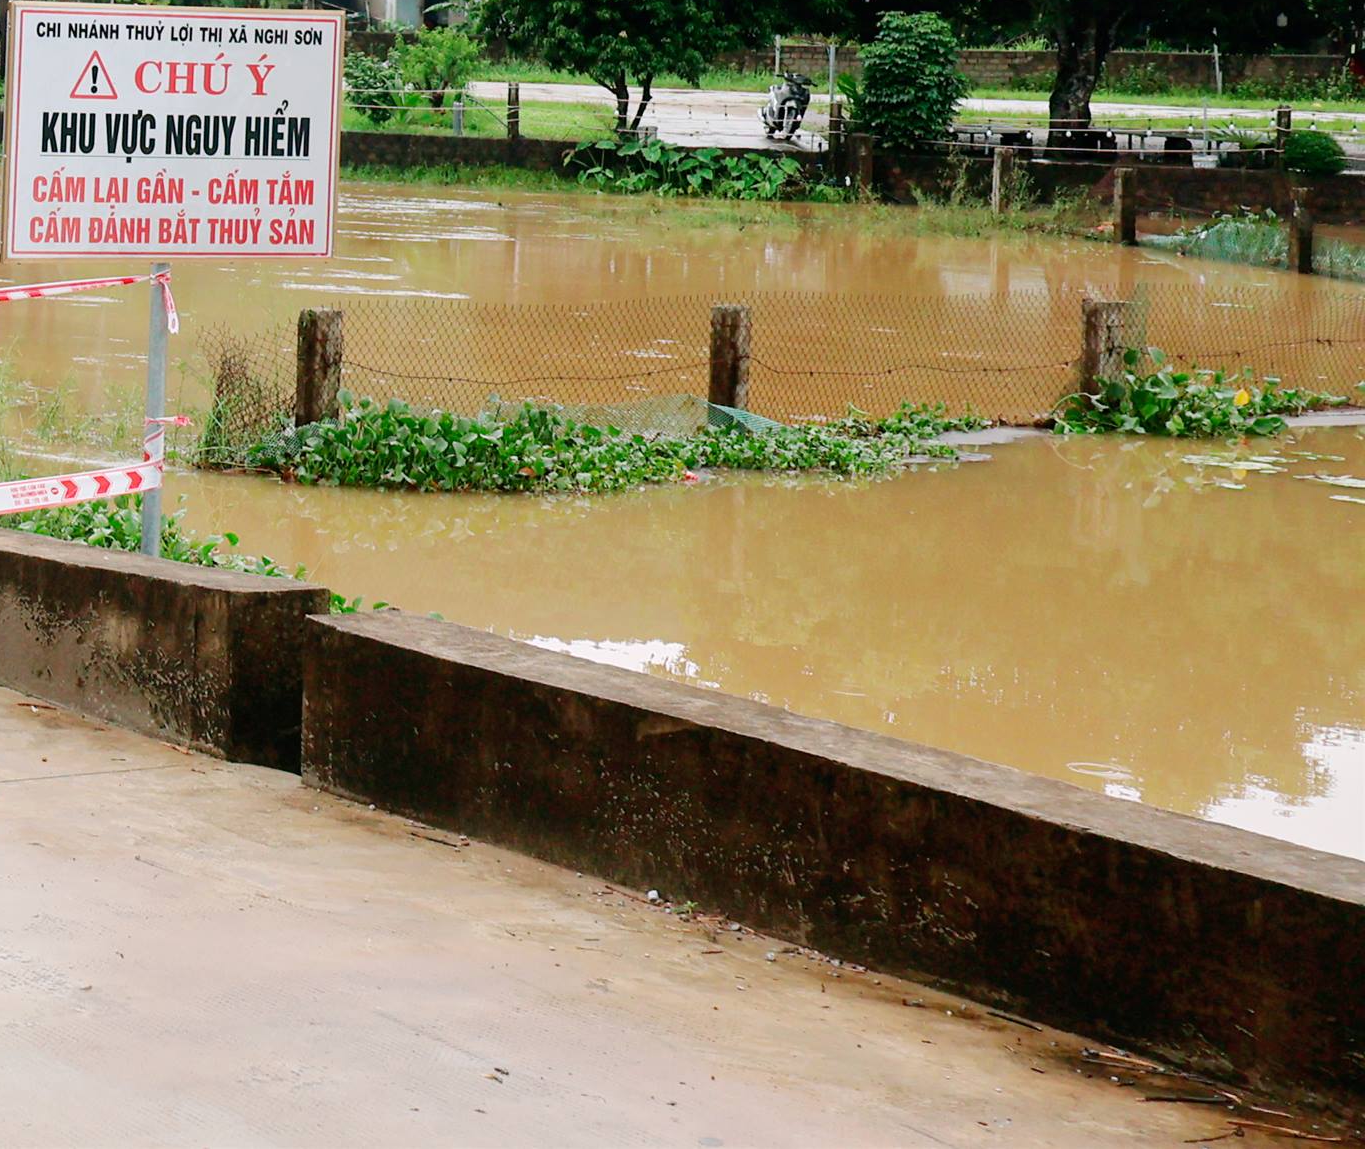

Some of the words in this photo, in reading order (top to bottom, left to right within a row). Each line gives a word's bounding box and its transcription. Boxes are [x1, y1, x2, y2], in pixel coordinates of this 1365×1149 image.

[36, 21, 62, 39] CHI
[67, 19, 120, 40] NHÁNH
[125, 19, 165, 42] THUỶ
[170, 22, 194, 47] LỢI
[199, 26, 223, 48] THỊ
[228, 24, 248, 44] XÃ
[253, 28, 289, 45] NGHI
[294, 26, 323, 46] SƠN
[134, 52, 233, 96] CHÚ
[245, 53, 276, 97] Ý
[40, 111, 97, 155] KHU
[103, 108, 159, 164] VỰC
[164, 114, 237, 157] NGUY
[243, 99, 311, 158] HIỂM
[32, 166, 86, 203] CẤM
[93, 176, 129, 211] LẠI
[136, 168, 184, 205] GẦN
[207, 169, 259, 205] CẤM
[265, 170, 315, 206] TẮM
[29, 207, 81, 244] CẤM
[87, 210, 151, 244] ĐÁNH
[157, 208, 201, 245] BẮT
[206, 207, 263, 246] THUỶ
[268, 207, 315, 246] SẢN
